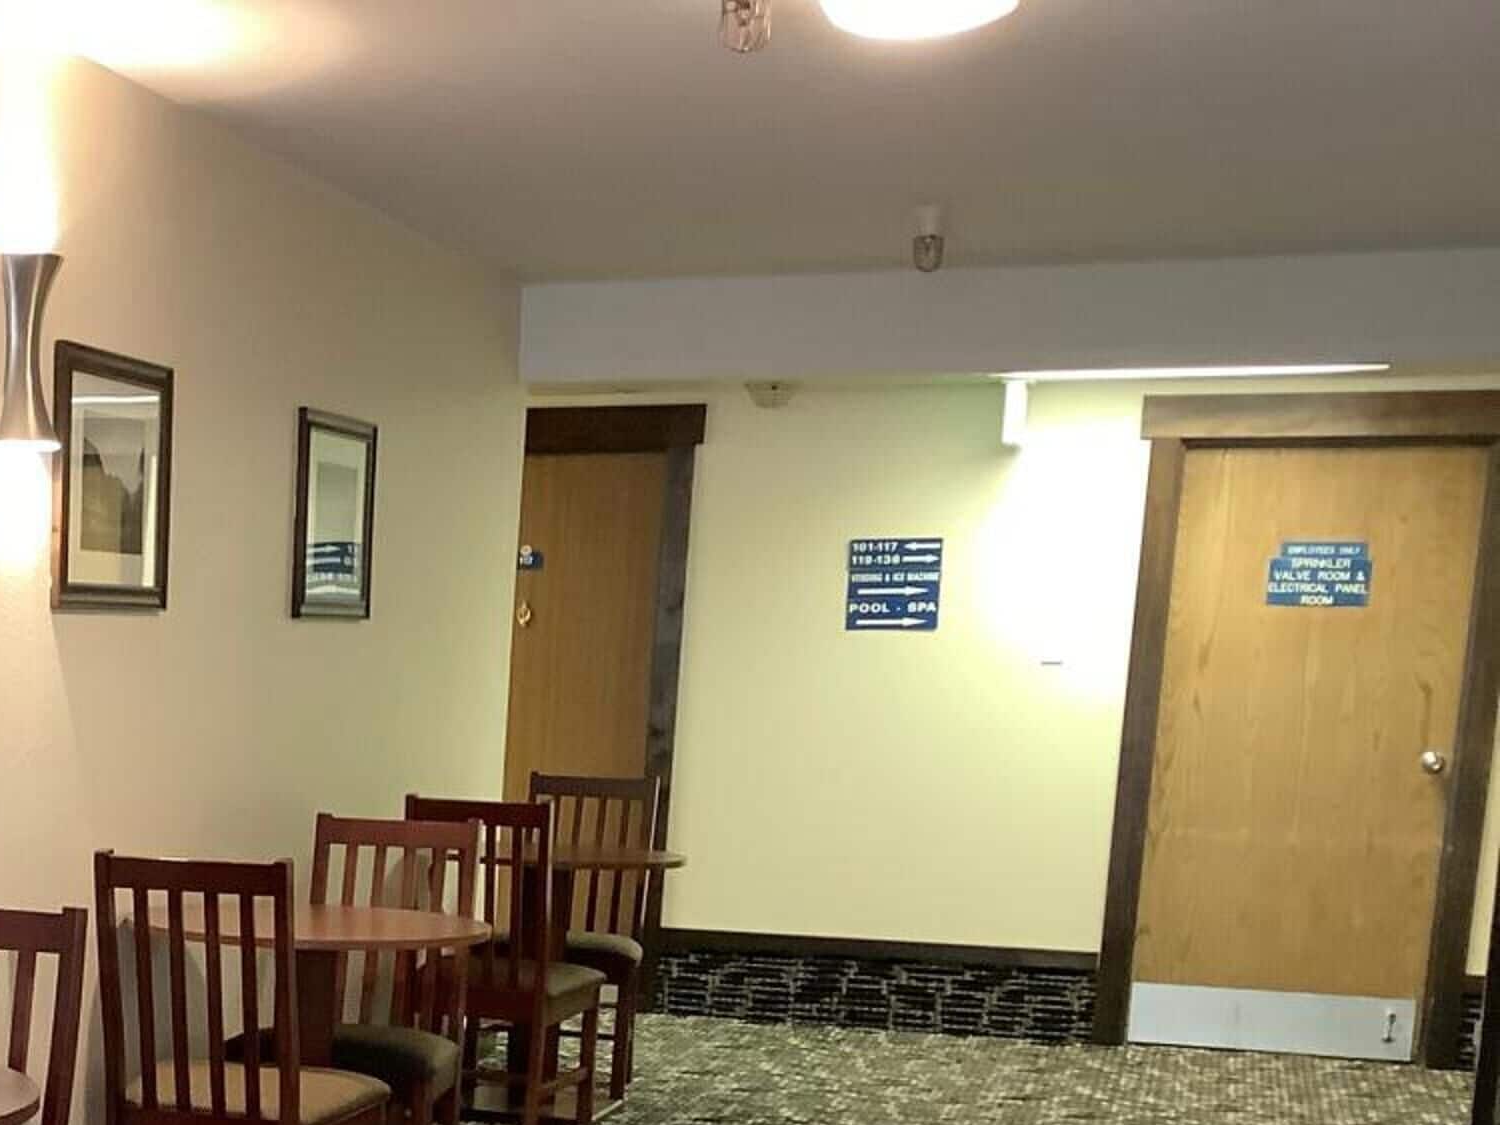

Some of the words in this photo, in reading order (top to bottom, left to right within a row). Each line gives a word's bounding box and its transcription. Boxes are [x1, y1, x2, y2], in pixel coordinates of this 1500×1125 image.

[852, 542, 899, 552] 101-117
[1292, 558, 1351, 569] SPRINKLER
[1273, 570, 1311, 580] VALVE
[1318, 570, 1350, 581] ROOM
[1268, 582, 1328, 592] ELECTRICAL
[1335, 583, 1368, 593] PANEL
[1301, 594, 1333, 605] ROOM
[849, 602, 890, 613] POOL
[907, 602, 936, 613] SPA
